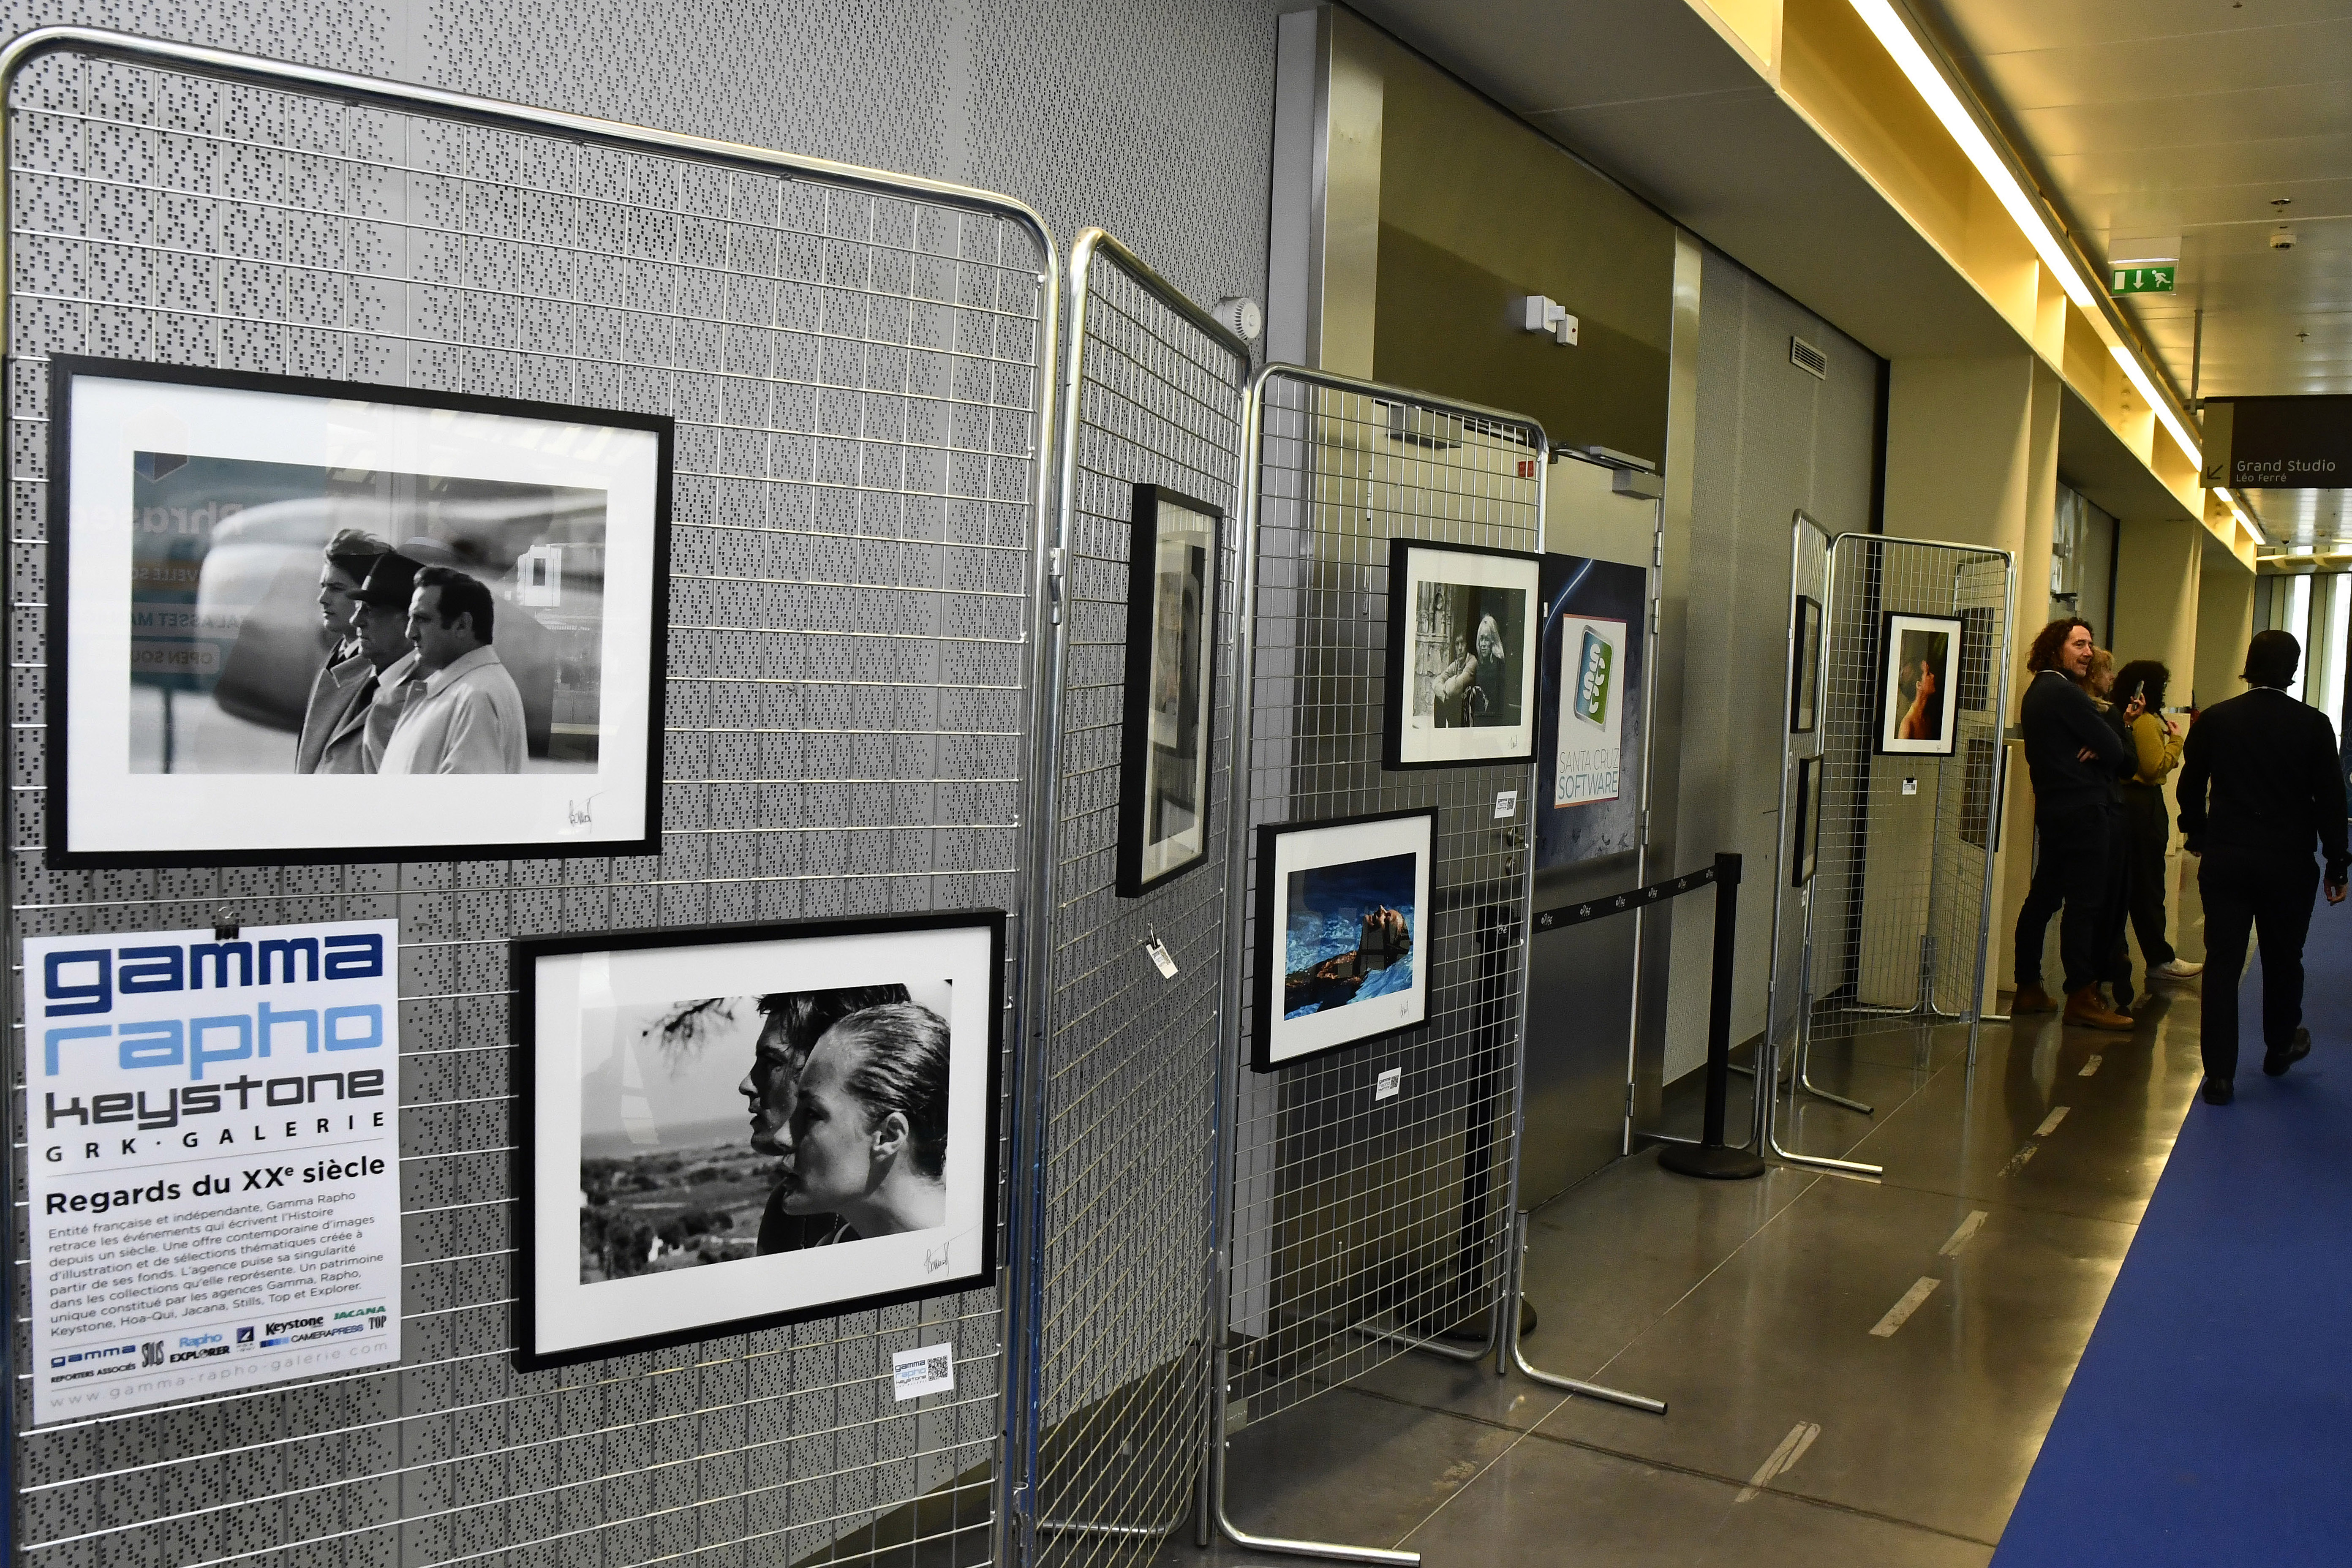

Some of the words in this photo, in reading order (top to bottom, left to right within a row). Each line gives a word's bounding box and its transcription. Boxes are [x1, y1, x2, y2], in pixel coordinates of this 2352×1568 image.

[2236, 473, 2254, 482] Léo
[2258, 473, 2287, 482] Ferré
[2237, 460, 2281, 471] Grand
[2288, 460, 2336, 471] Studio
[1560, 750, 1591, 774] SANTA
[1594, 747, 1619, 770] CRUZ
[1559, 770, 1618, 800] SOFTWARE
[44, 933, 383, 1017] gamma
[44, 1001, 383, 1081] rapho
[46, 1069, 384, 1130] keystone
[46, 1180, 181, 1214] Regards
[192, 1175, 230, 1196] du
[303, 1156, 384, 1182] siècle
[49, 1225, 88, 1239] Entité
[93, 1218, 152, 1232] française
[156, 1215, 169, 1225] et
[266, 1198, 313, 1210] Gamma
[317, 1192, 355, 1203] Rapho
[49, 1240, 96, 1252] retrace
[101, 1237, 119, 1245] les
[205, 1221, 224, 1233] qui
[228, 1214, 278, 1229] écrivent
[49, 1254, 94, 1267] depuis
[98, 1251, 114, 1260] un
[163, 1241, 188, 1251] Une
[192, 1236, 222, 1247] offre
[226, 1223, 318, 1243] contemporaine
[136, 1259, 149, 1269] et
[153, 1257, 170, 1266] de
[174, 1248, 237, 1263] sélections
[240, 1237, 316, 1254] thématiques
[319, 1231, 352, 1243] créée
[356, 1229, 362, 1238] à
[49, 1282, 87, 1297] partir
[91, 1279, 108, 1289] de
[112, 1277, 133, 1286] ses
[241, 1256, 273, 1269] puise
[277, 1254, 291, 1262] sa
[294, 1243, 356, 1260] singularité
[50, 1298, 82, 1309] dans
[87, 1295, 105, 1304] les
[109, 1283, 180, 1300] collections
[299, 1263, 316, 1272] Un
[320, 1254, 383, 1271] patrimoine
[50, 1309, 97, 1323] unique
[100, 1298, 161, 1315] constitué
[166, 1295, 187, 1307] par
[191, 1293, 207, 1302] les
[211, 1284, 263, 1299] agences
[268, 1293, 291, 1302] Top
[294, 1290, 306, 1298] et
[266, 1316, 324, 1336] Keystone
[369, 1315, 387, 1330] TOP
[51, 1345, 136, 1368] gamma
[170, 1345, 231, 1363] EXPLORER
[180, 1334, 223, 1348] Rapho
[895, 1360, 926, 1372] gamma
